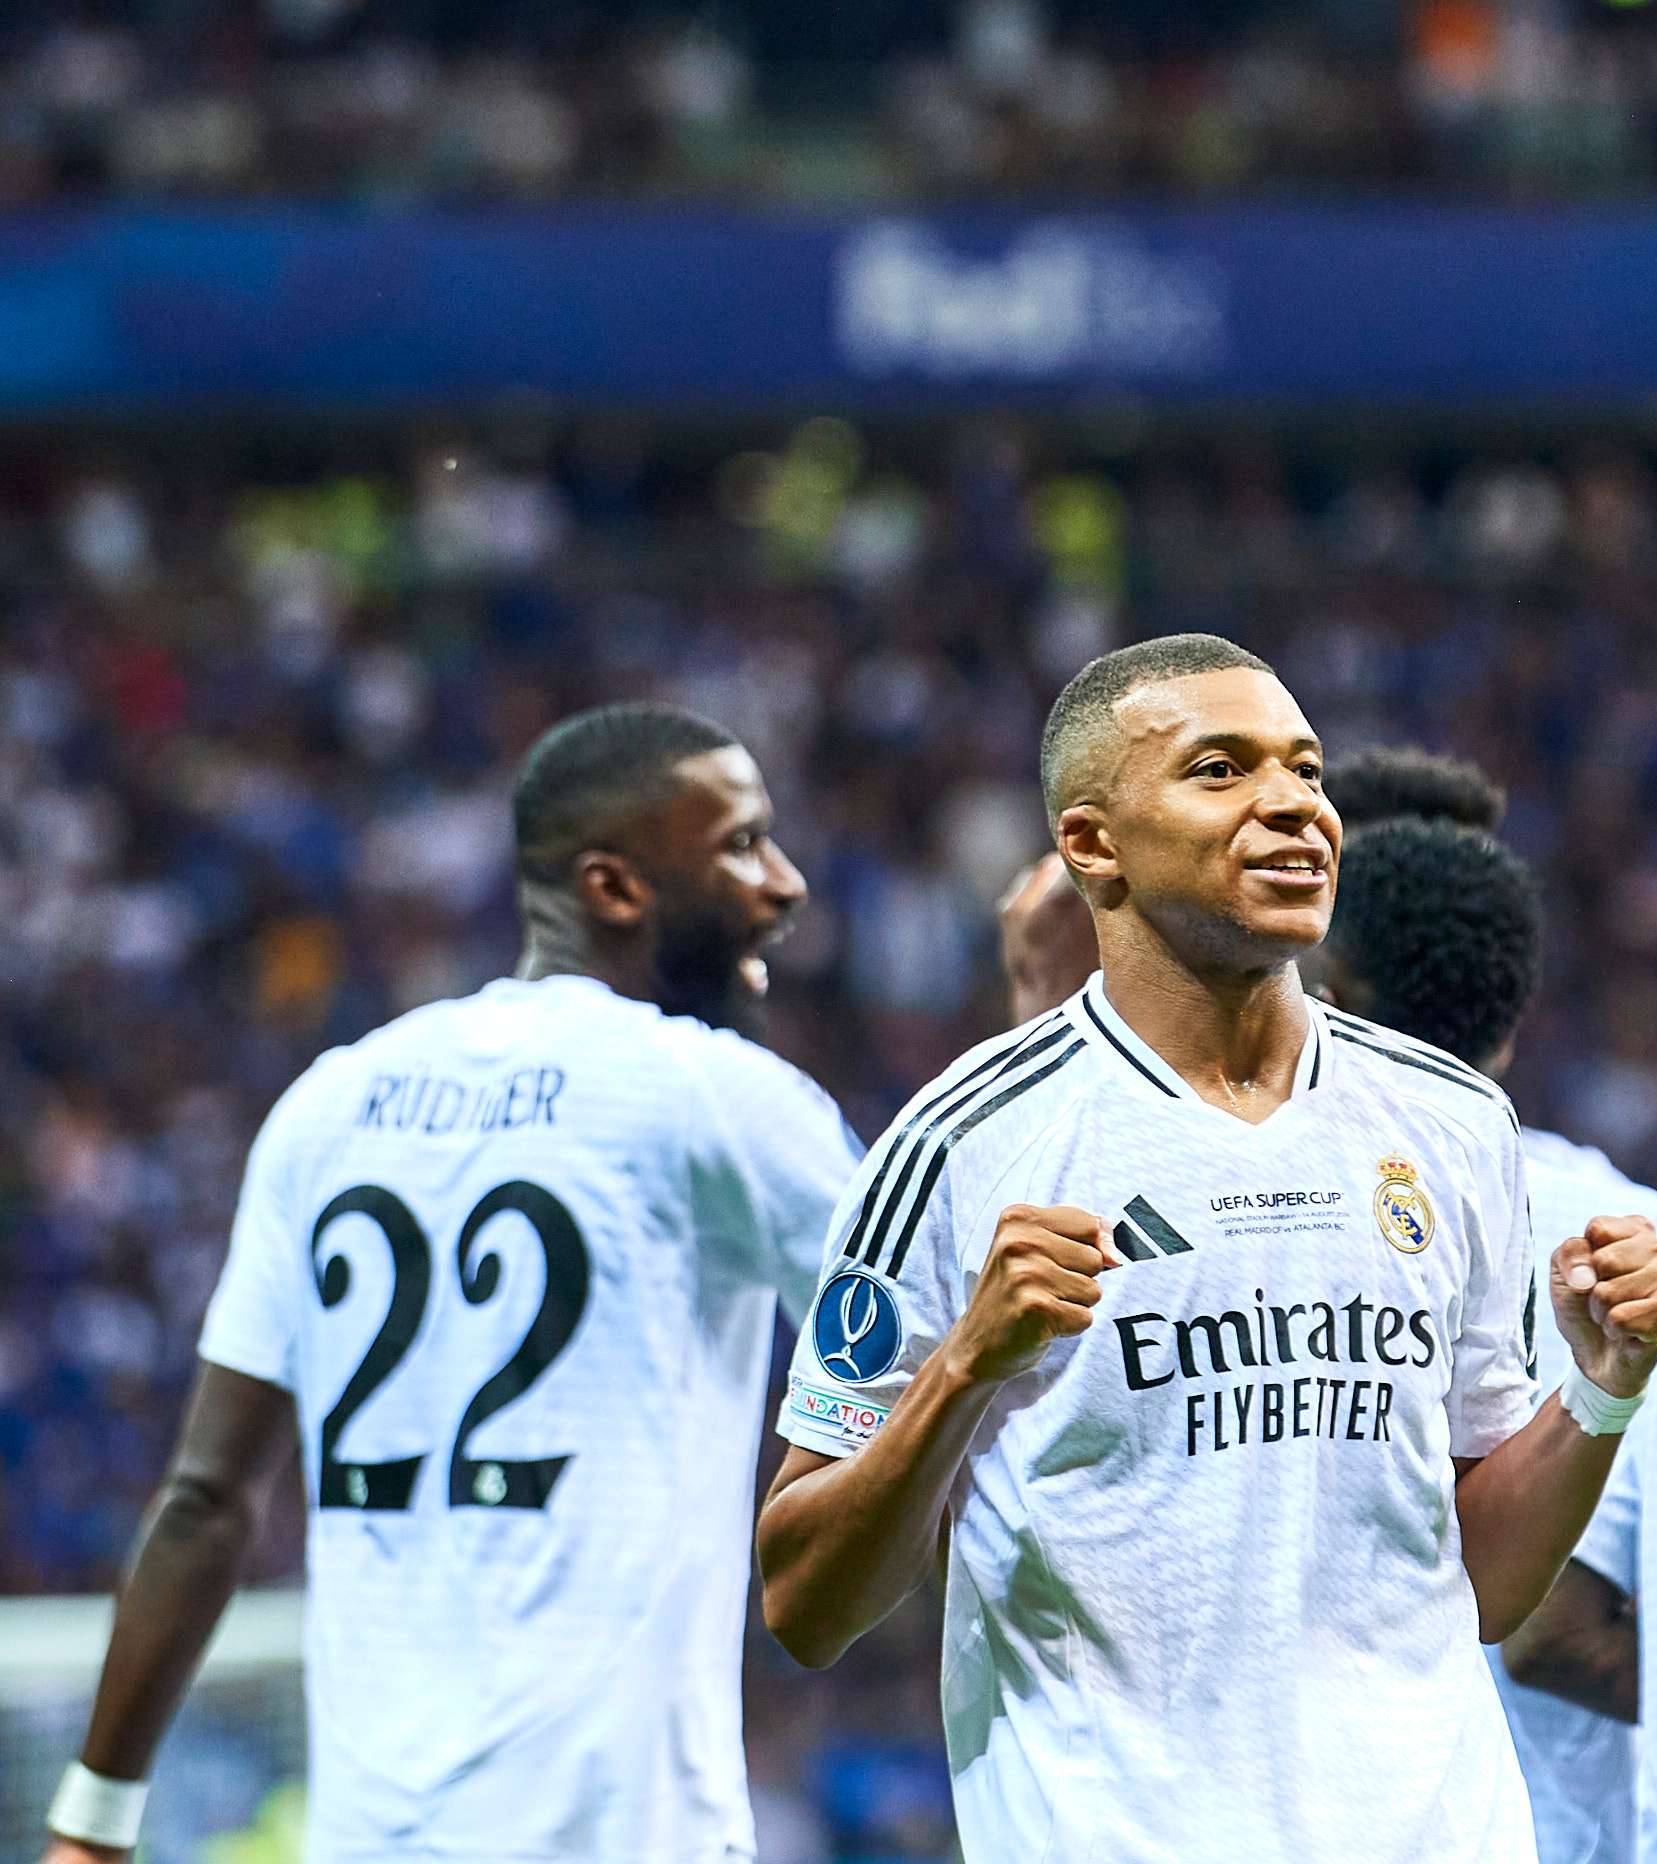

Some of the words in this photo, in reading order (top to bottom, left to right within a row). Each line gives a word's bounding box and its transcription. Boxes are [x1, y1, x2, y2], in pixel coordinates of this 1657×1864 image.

[1210, 1195, 1254, 1211] UEFA
[1256, 1192, 1308, 1207] SUPER
[1309, 1191, 1342, 1204] CUP
[1293, 1222, 1333, 1232] ATALANTA
[312, 1180, 592, 1512] 22
[1113, 1287, 1436, 1391] Emirates
